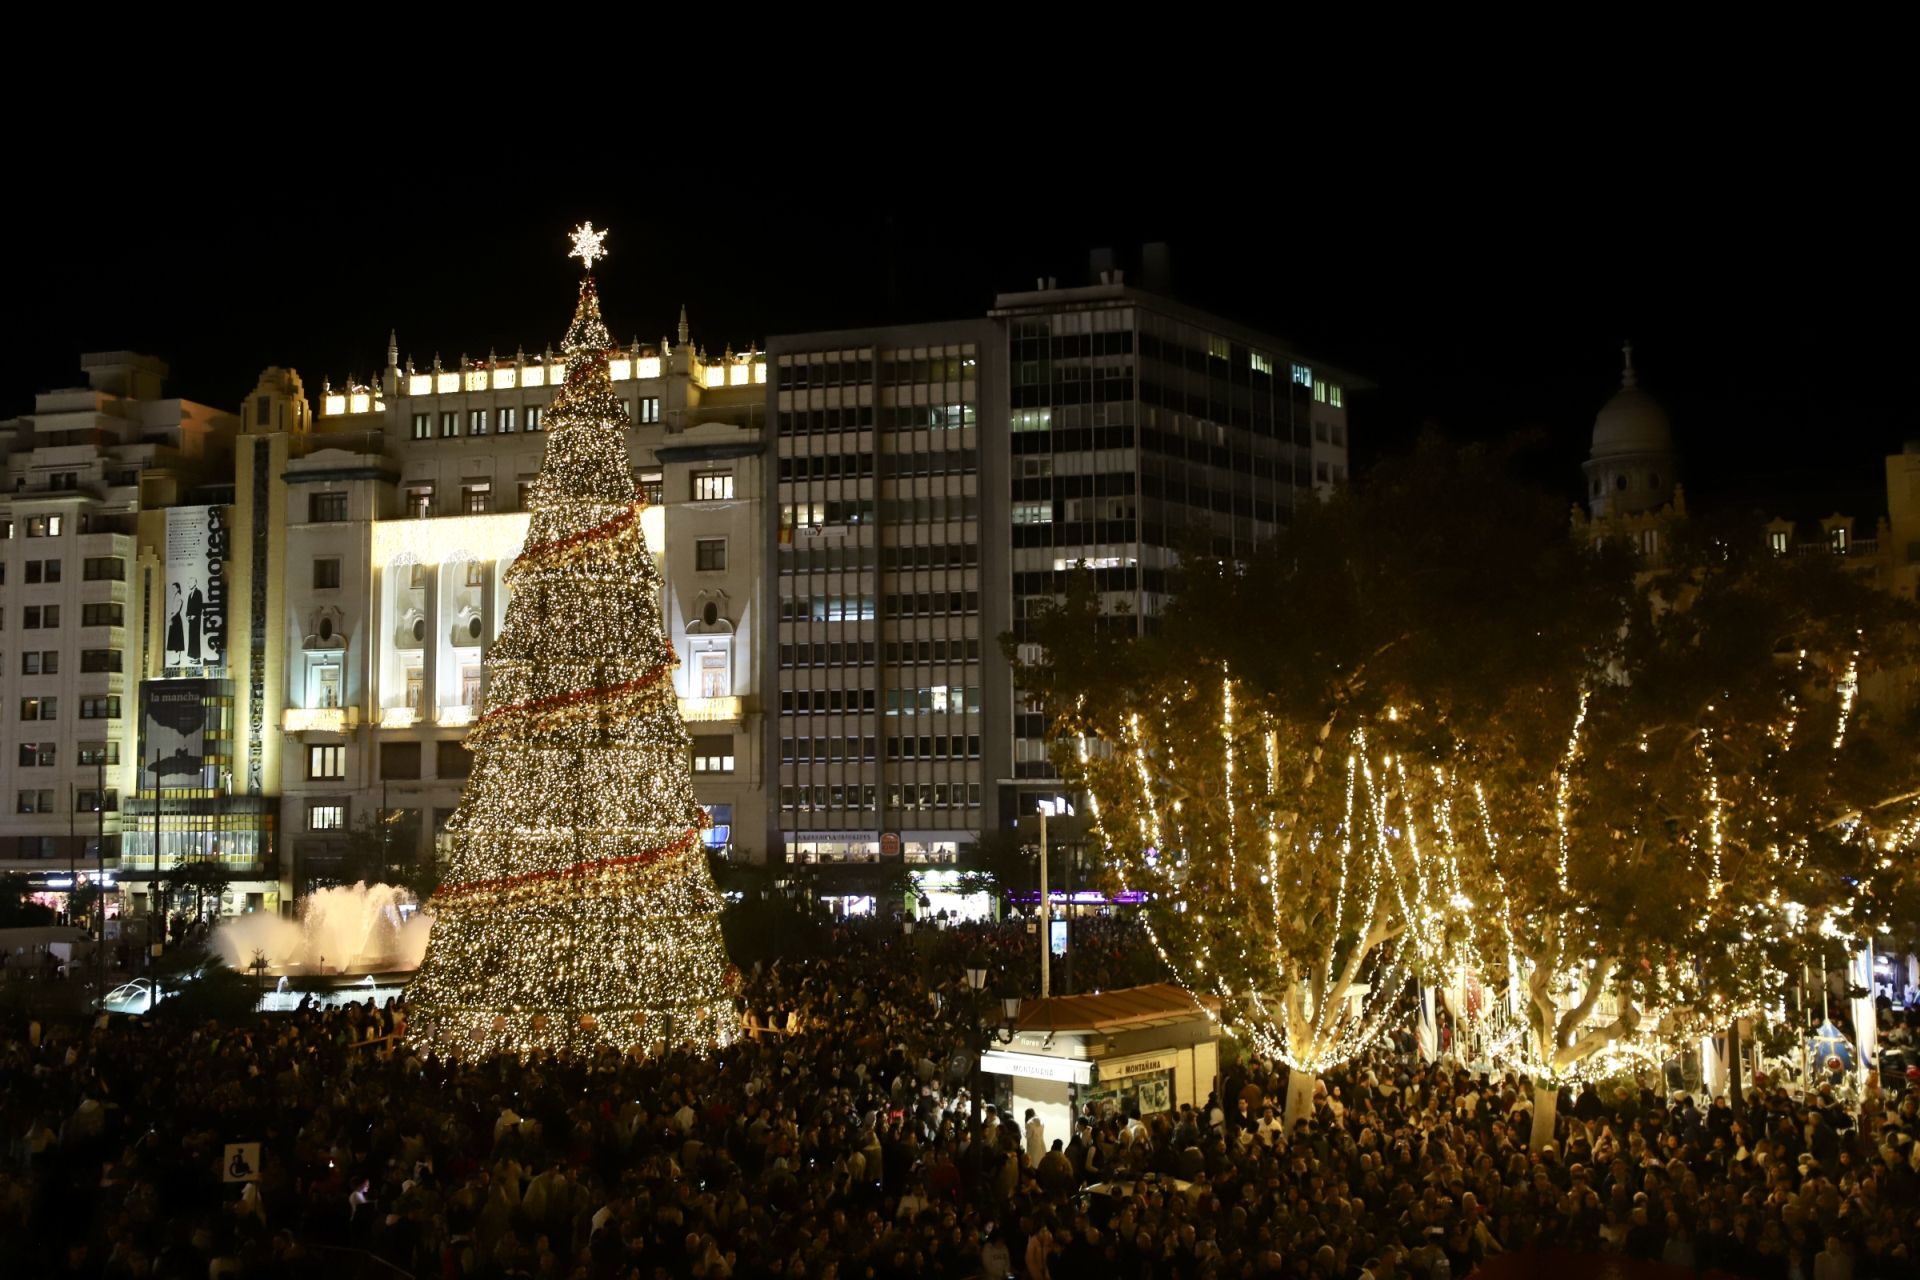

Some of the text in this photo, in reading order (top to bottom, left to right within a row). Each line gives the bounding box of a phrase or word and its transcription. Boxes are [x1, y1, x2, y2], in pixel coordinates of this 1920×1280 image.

[151, 691, 200, 702] la mancha
[1125, 1060, 1161, 1073] MONTAÑANA
